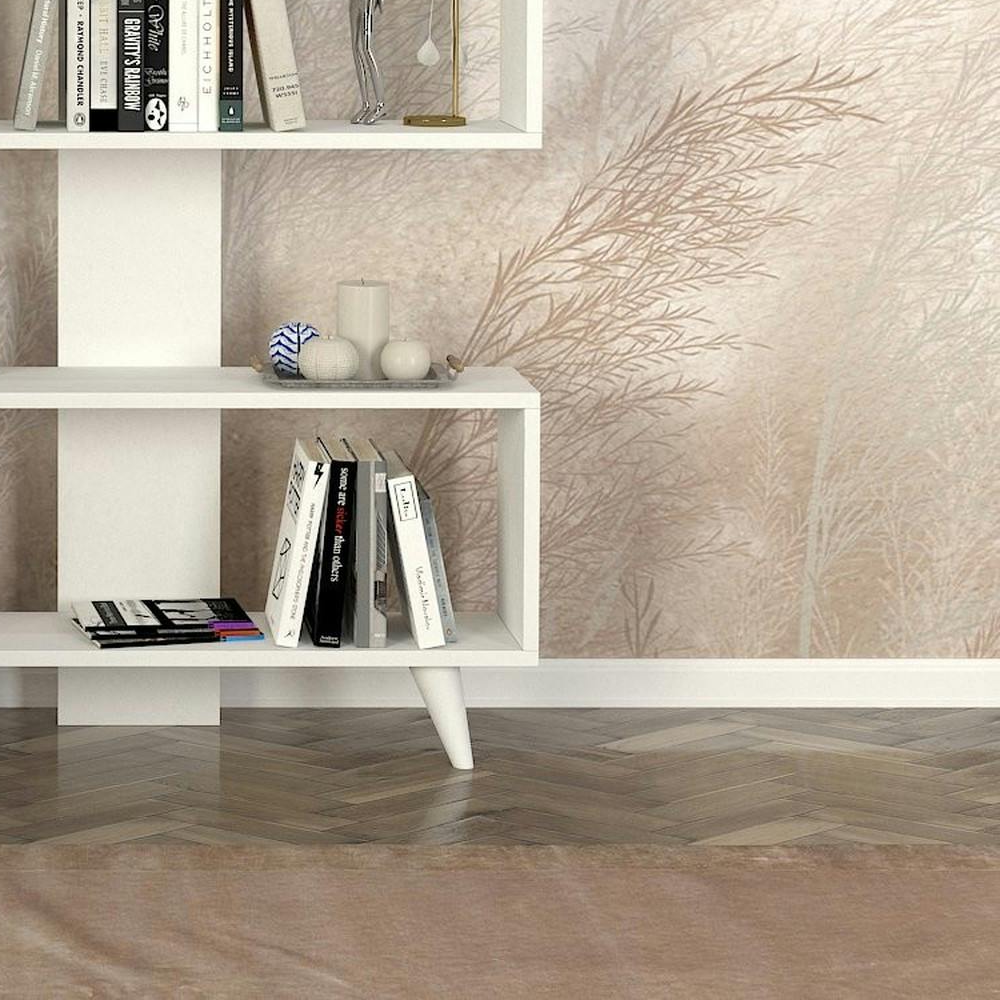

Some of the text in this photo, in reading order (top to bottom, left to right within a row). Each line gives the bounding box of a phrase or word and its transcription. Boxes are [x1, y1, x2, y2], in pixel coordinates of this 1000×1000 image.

[148, 5, 165, 51] White
[99, 61, 108, 103] EVE CHASE
[123, 18, 140, 111] GRAVITY'S RAINBOW
[330, 467, 349, 582] some are sicker than others
